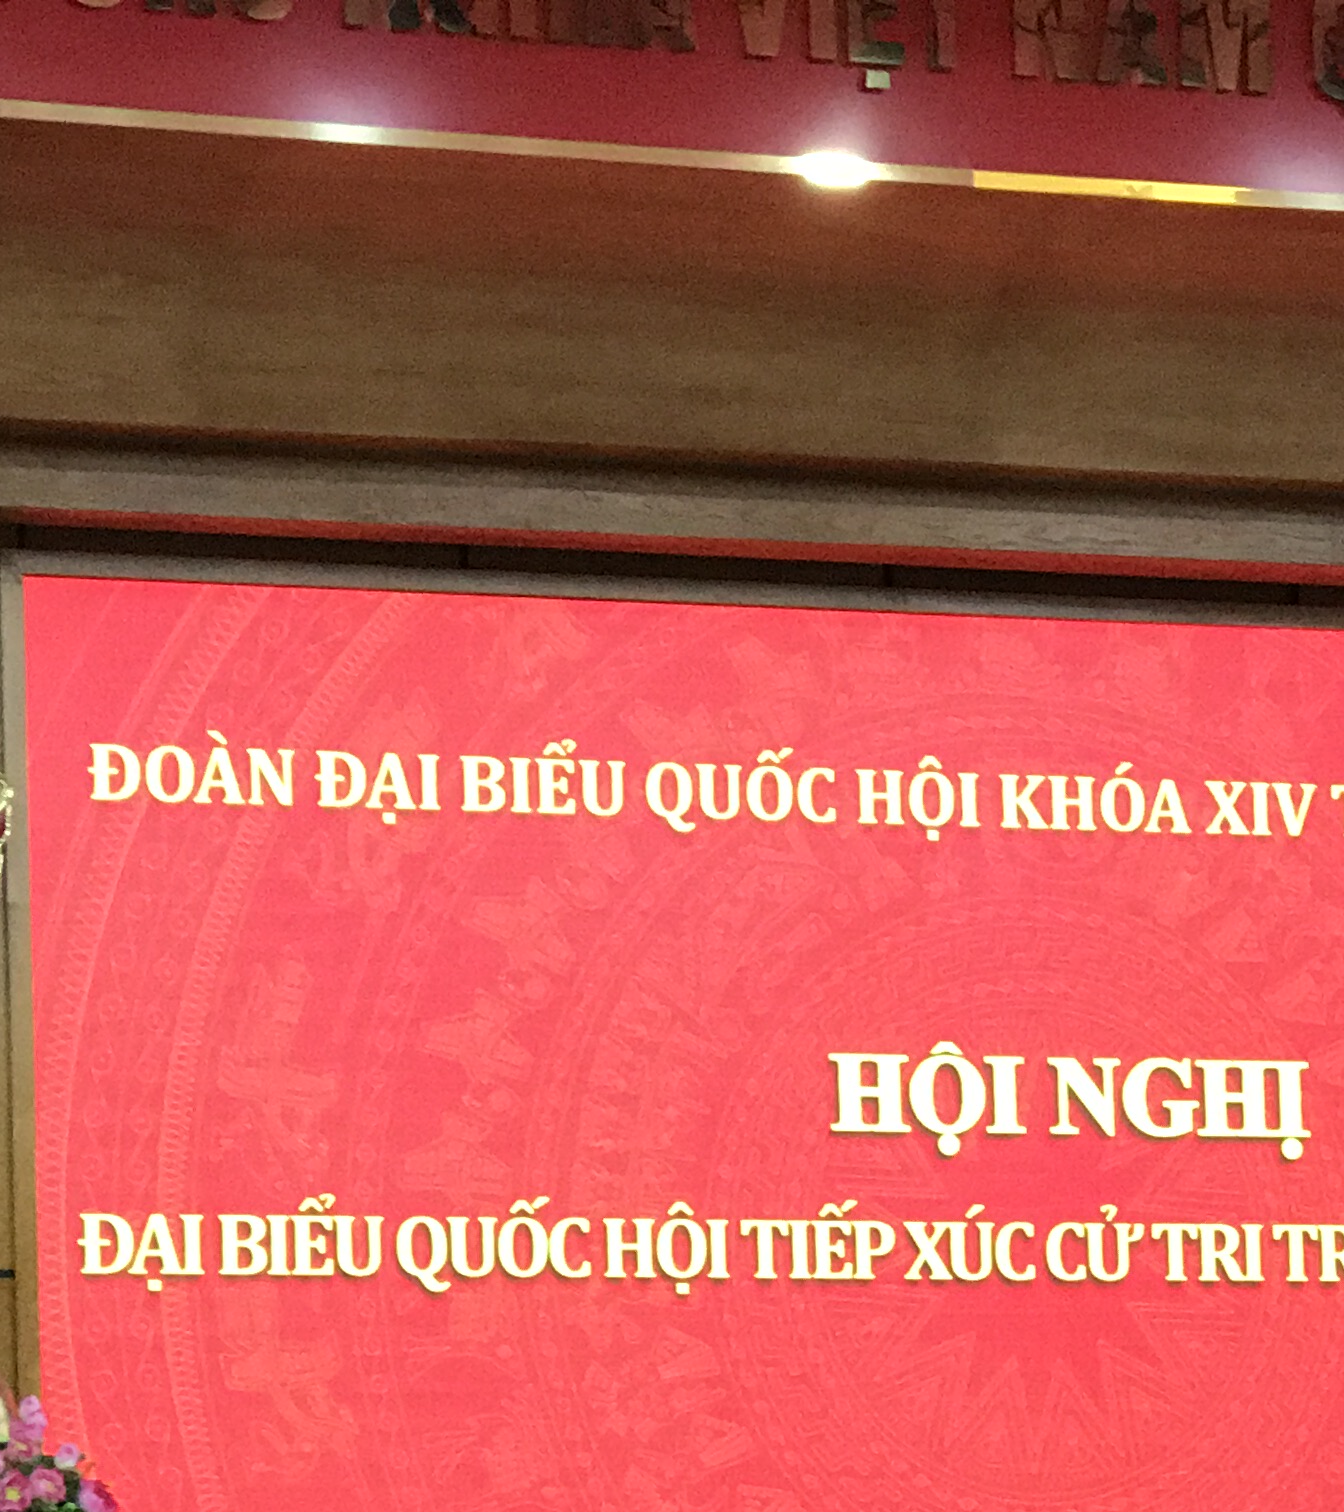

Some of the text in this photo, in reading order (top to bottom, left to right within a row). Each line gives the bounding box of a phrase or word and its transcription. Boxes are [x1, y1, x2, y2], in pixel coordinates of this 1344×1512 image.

[88, 730, 295, 806] ĐOÀN
[314, 750, 441, 824] ĐẠI
[460, 739, 626, 817] BIỂU
[645, 747, 836, 832] QUỐC
[855, 755, 981, 841] HỘI
[999, 762, 1192, 834] KHÓA
[1205, 781, 1317, 836] XIV
[828, 1041, 1311, 1160] HỘI NGHỊ
[77, 1213, 205, 1291] ĐẠI
[218, 1193, 384, 1277] BIỂU
[396, 1196, 591, 1292] QUỐC
[603, 1201, 730, 1294] HỘI
[740, 1200, 896, 1279] TIẾP
[903, 1204, 1036, 1281] XÚC
[1046, 1204, 1145, 1281] CỬ
[1151, 1223, 1267, 1281] TRI
